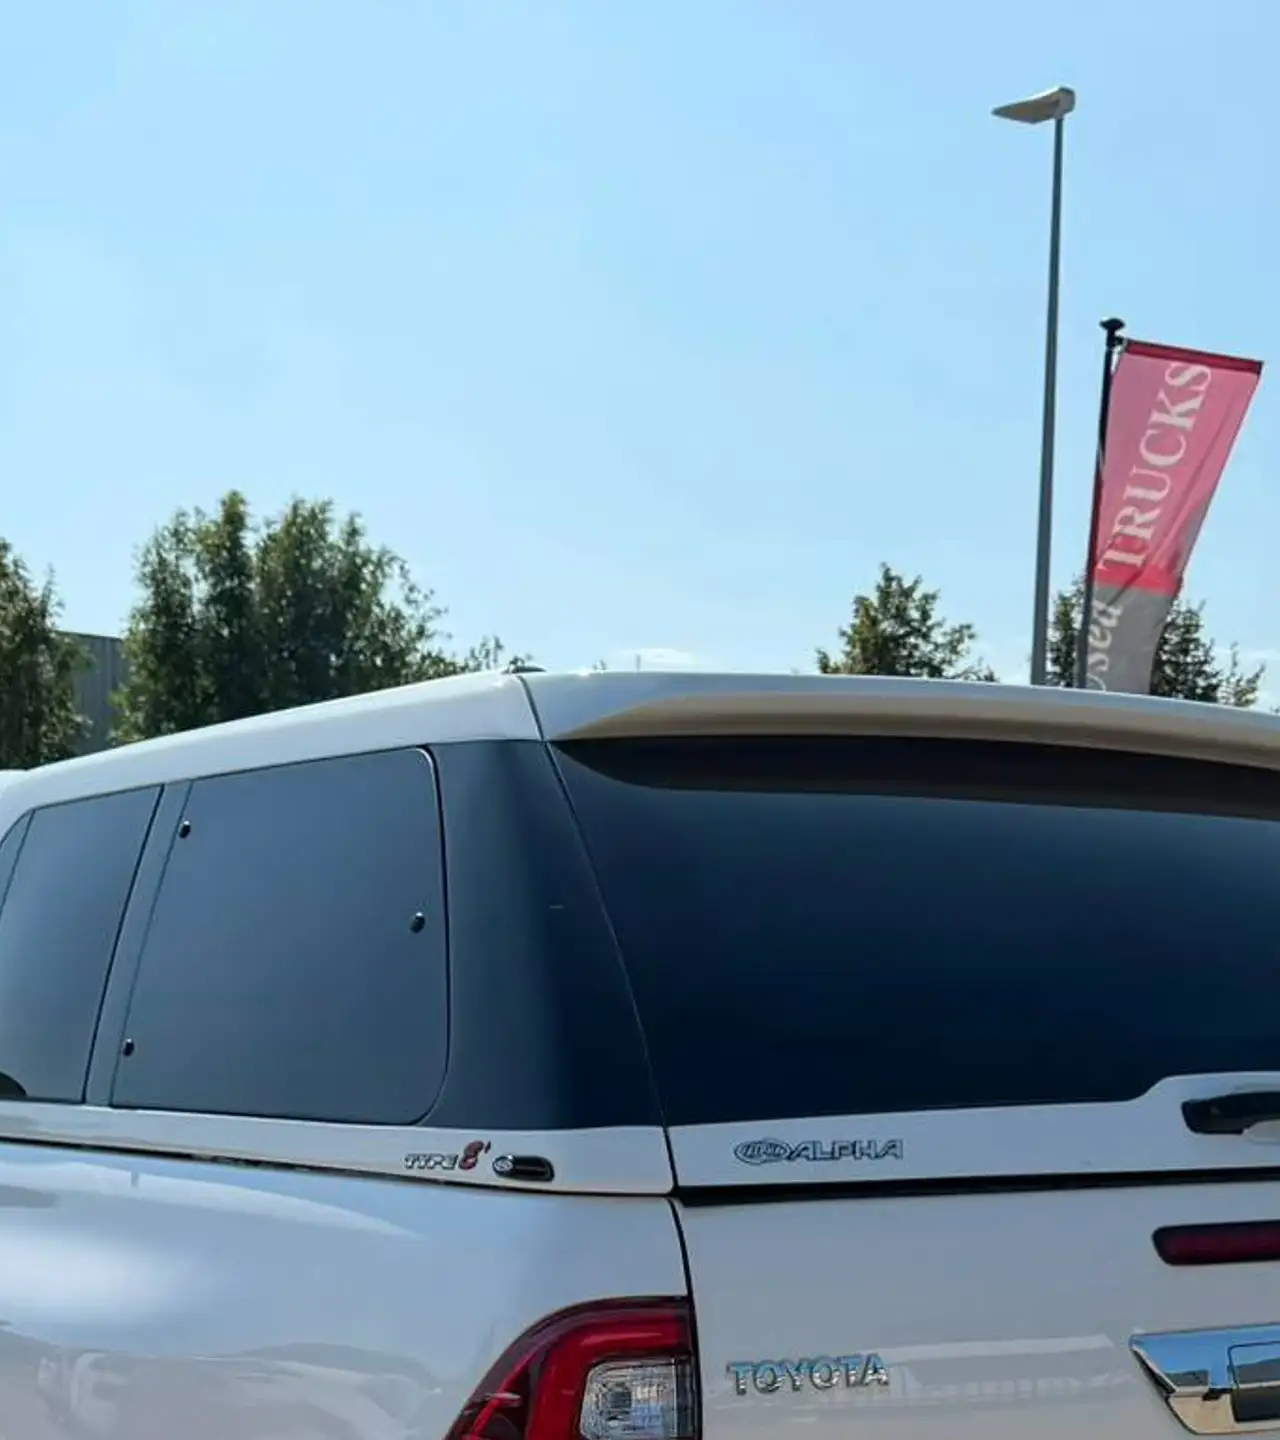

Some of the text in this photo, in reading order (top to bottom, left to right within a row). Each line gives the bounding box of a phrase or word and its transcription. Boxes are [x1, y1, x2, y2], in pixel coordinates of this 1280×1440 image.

[1097, 361, 1212, 571] TRUCKS
[786, 1138, 904, 1162] ALPHA
[725, 1352, 889, 1396] TOYOTA
